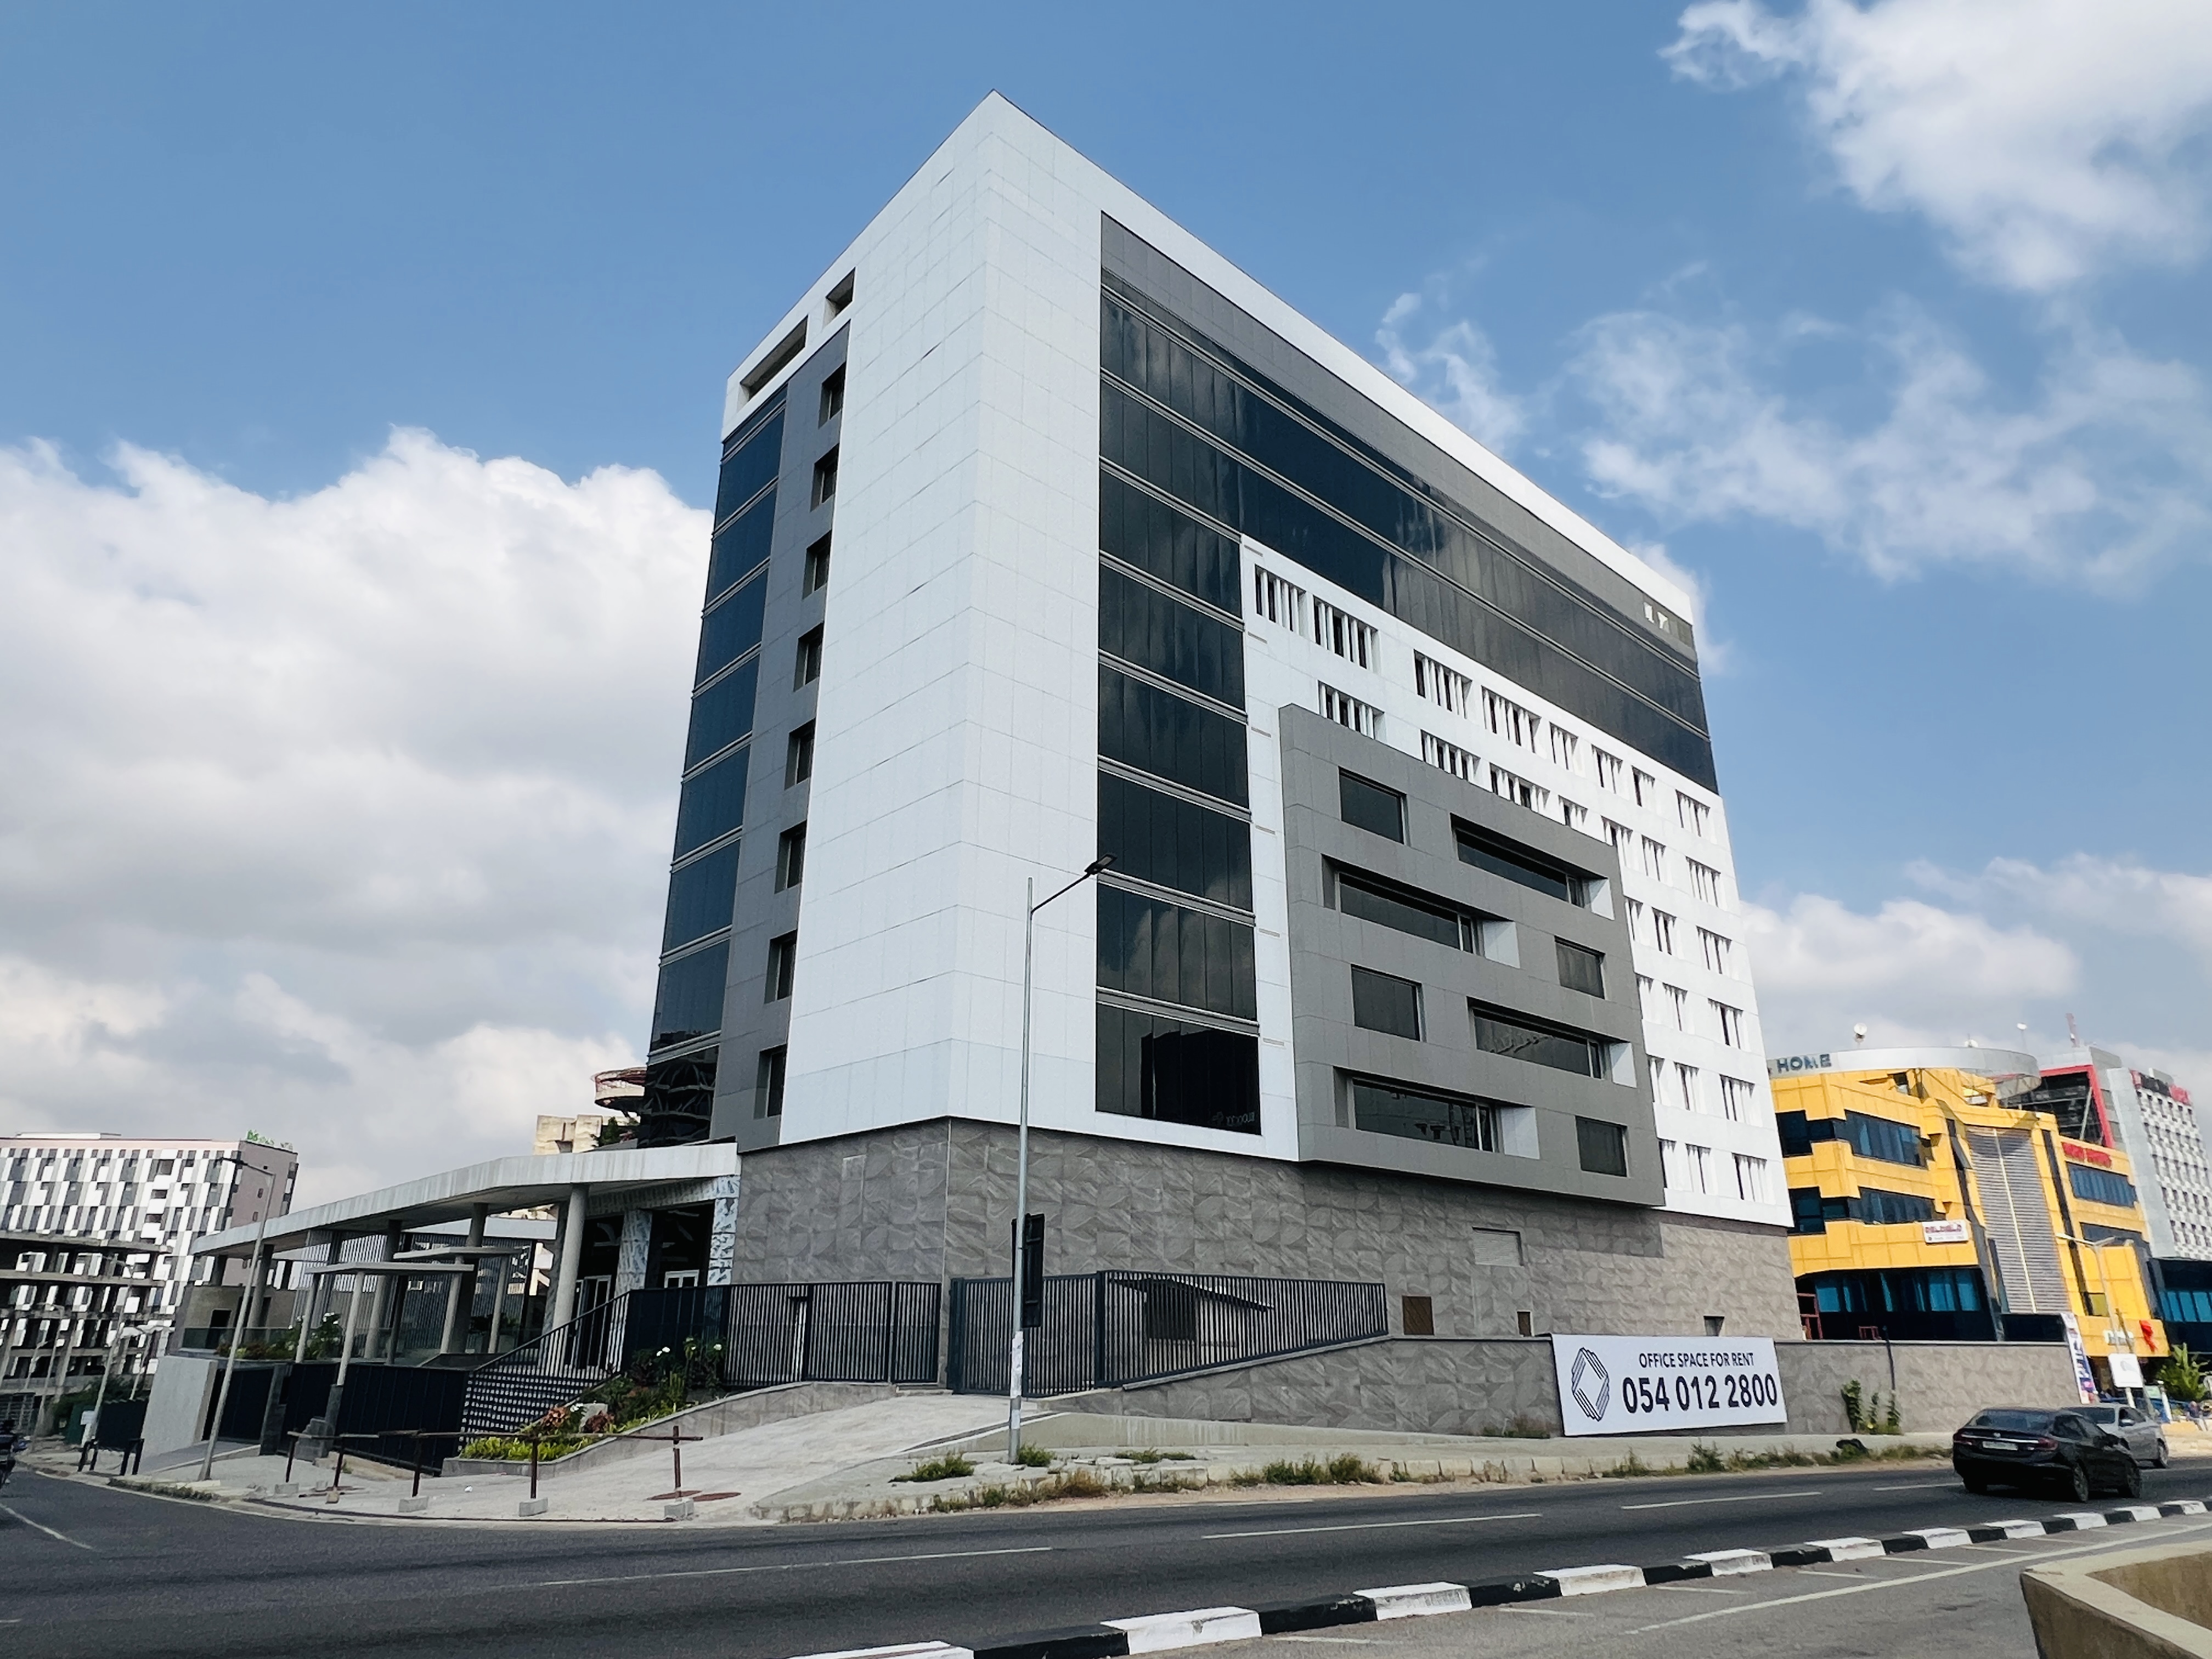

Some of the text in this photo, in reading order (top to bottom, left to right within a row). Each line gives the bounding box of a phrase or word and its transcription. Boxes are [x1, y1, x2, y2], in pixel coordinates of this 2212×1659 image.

[1639, 1352, 1754, 1368] OFFICE SPACE FOR RENT
[1623, 1374, 1778, 1414] 054 012 2800
